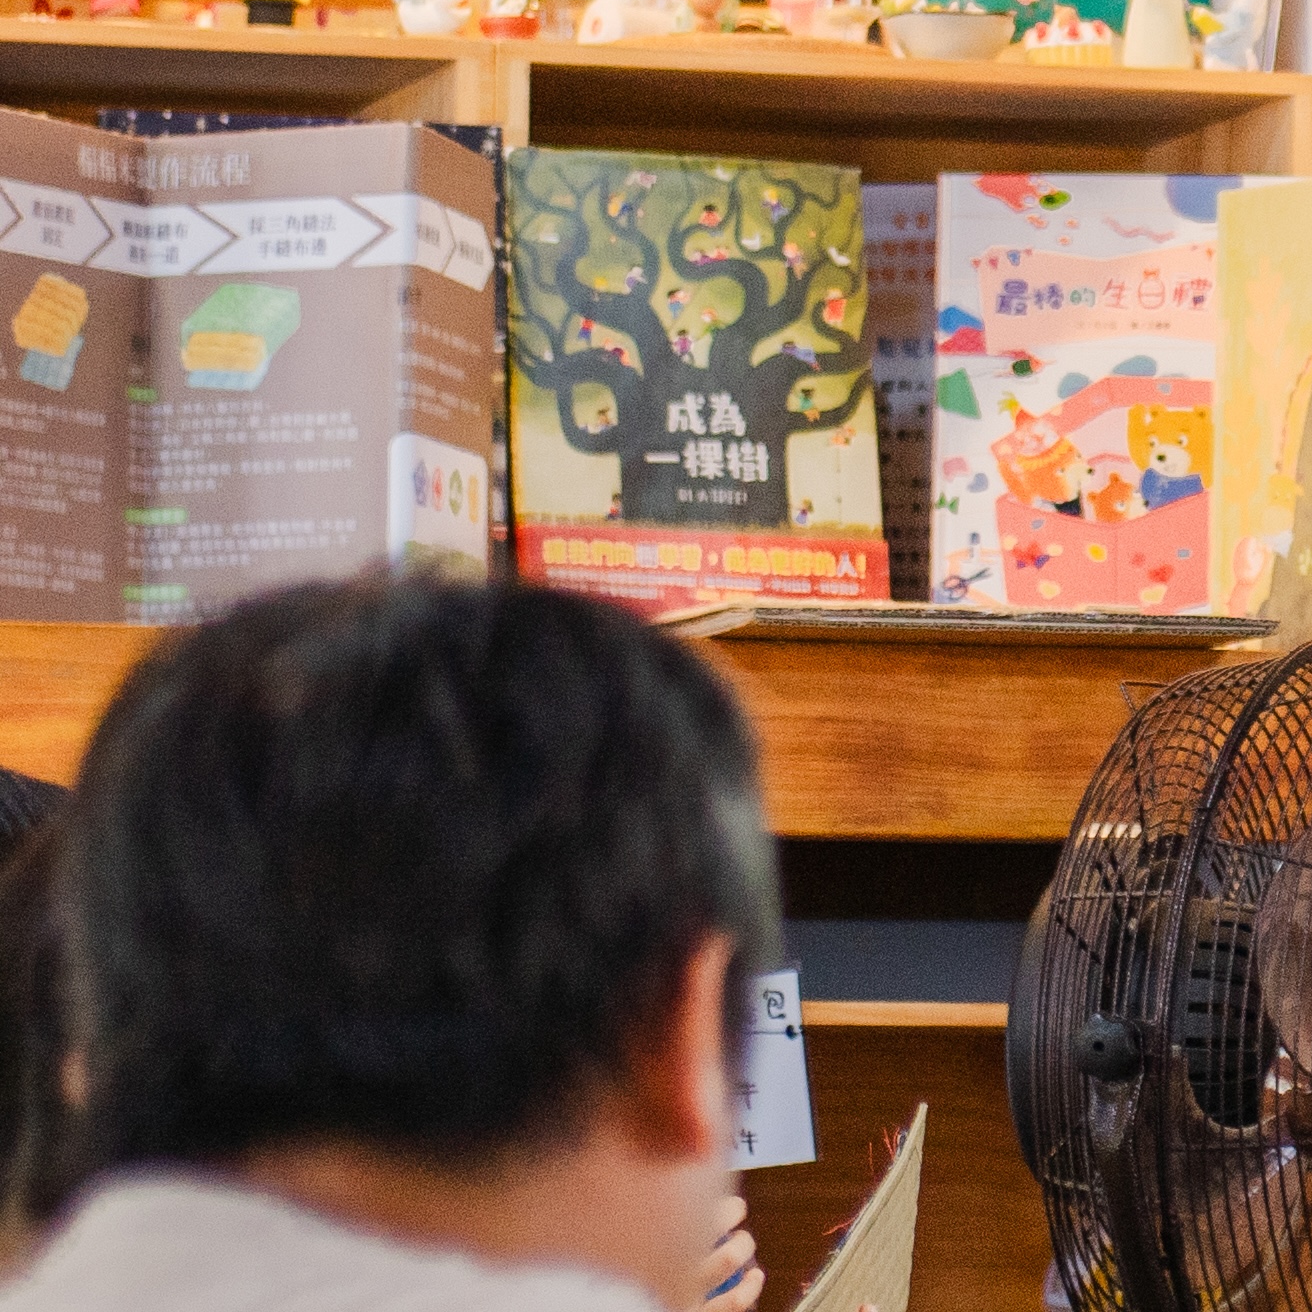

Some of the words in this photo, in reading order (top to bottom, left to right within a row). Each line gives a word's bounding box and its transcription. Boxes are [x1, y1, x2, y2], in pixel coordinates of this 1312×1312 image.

[667, 391, 746, 437] 成為
[644, 439, 769, 483] 一棵樹
